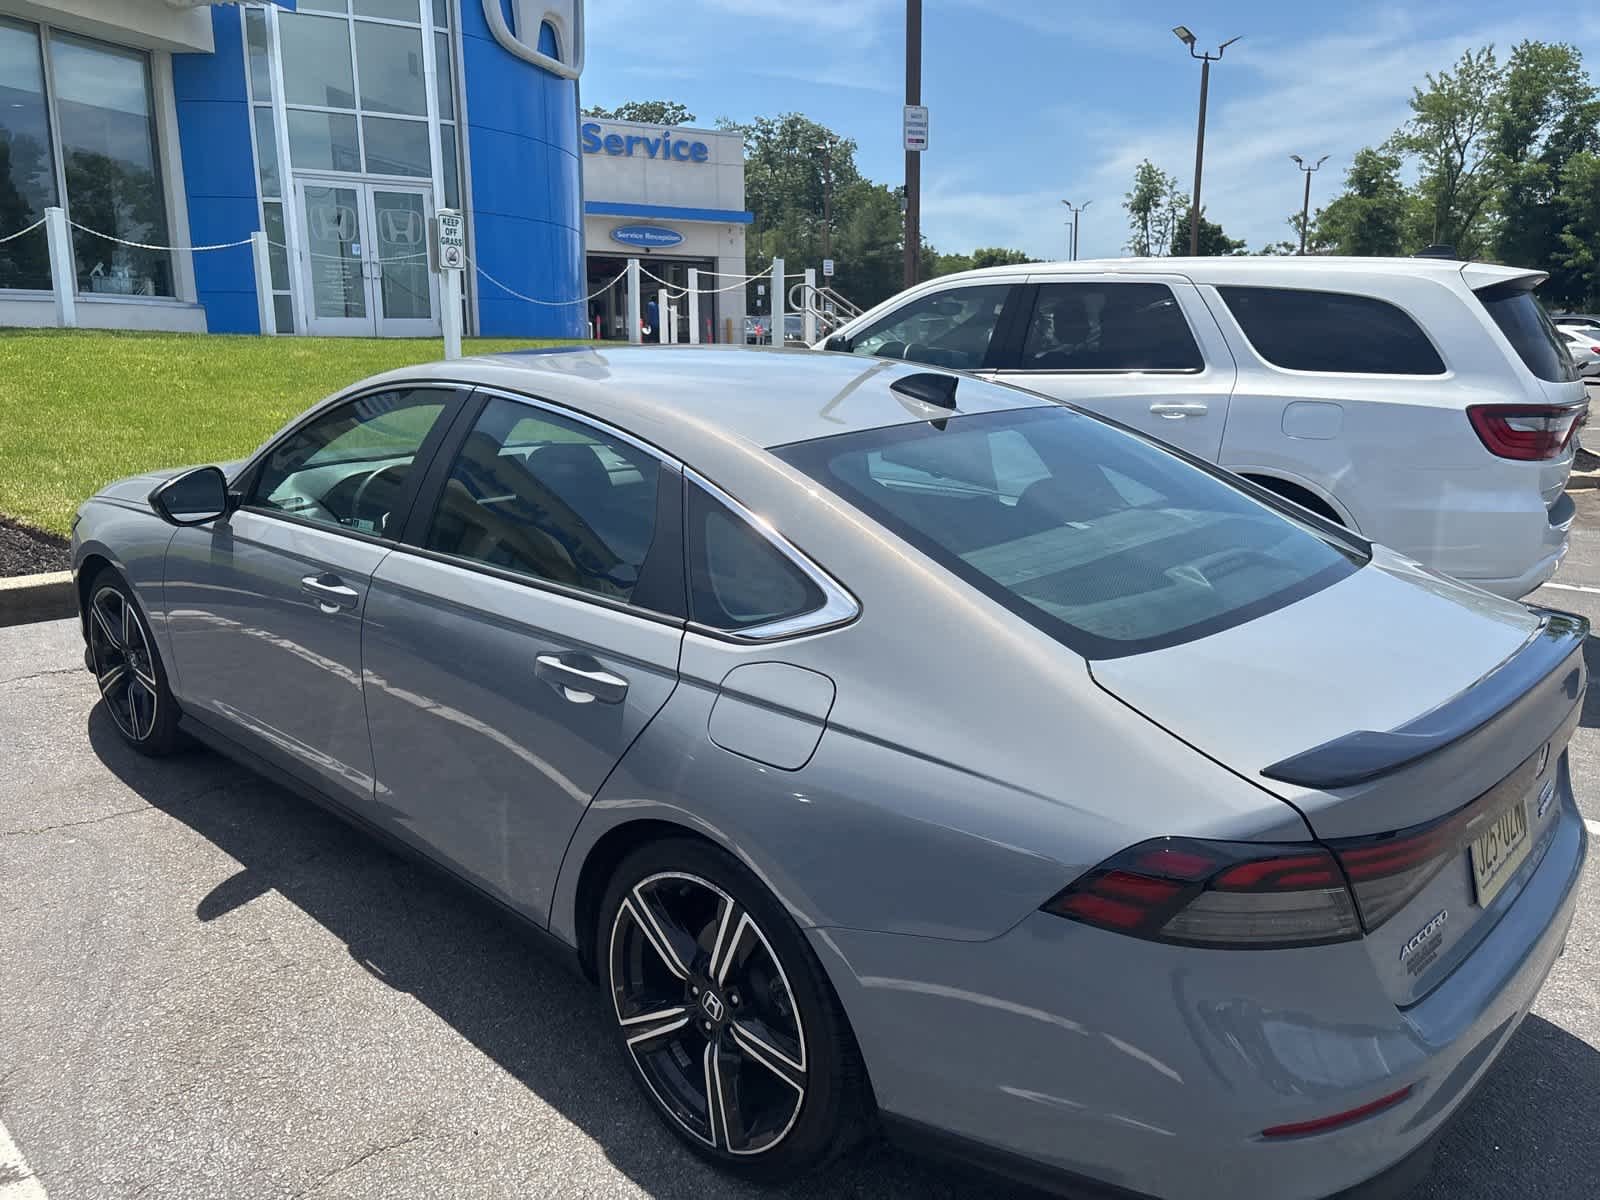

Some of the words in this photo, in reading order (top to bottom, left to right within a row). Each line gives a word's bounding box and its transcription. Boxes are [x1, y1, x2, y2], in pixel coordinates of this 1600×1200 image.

[582, 122, 709, 163] Service
[442, 217, 460, 226] KEEP
[445, 227, 458, 237] OFF
[616, 230, 643, 240] Service
[645, 231, 682, 243] Reception
[440, 236, 463, 248] GRASS
[1400, 909, 1448, 961] ACCORD
